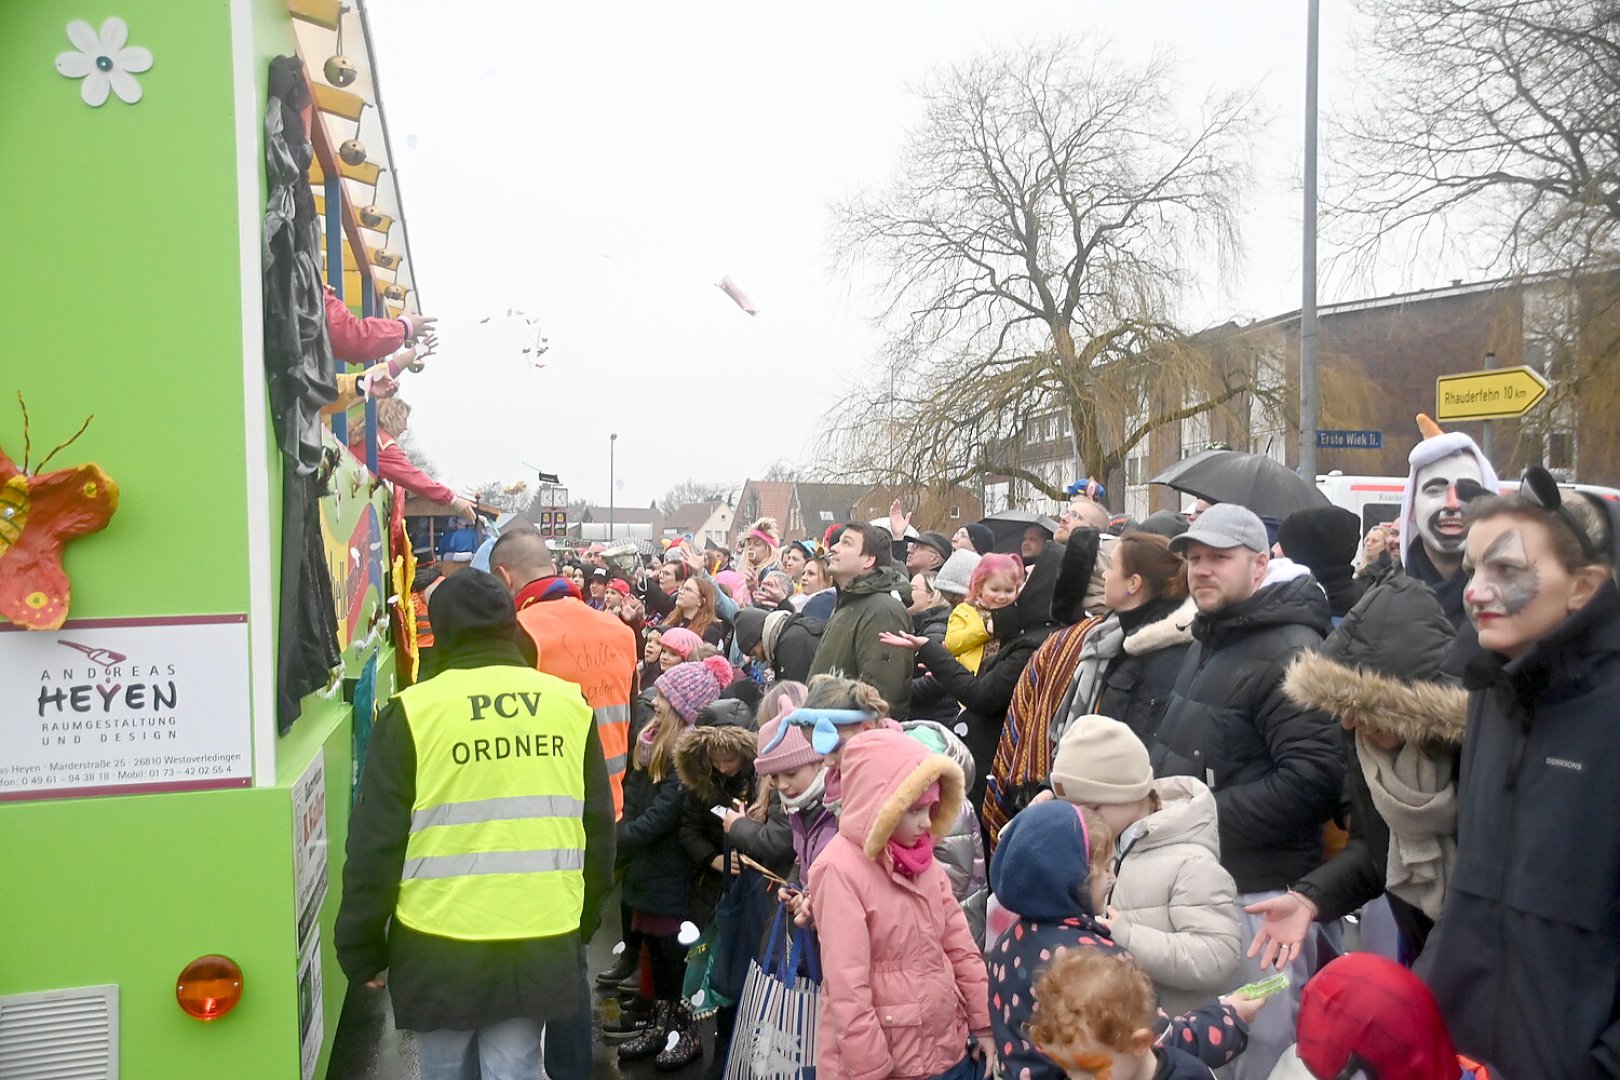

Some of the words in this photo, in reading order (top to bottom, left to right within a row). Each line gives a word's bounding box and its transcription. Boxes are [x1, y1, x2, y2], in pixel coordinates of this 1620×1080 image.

[1444, 389, 1500, 405] Rhauderfehn
[1504, 385, 1513, 400] 10
[1515, 389, 1527, 399] km
[1320, 432, 1344, 444] Erste
[1346, 432, 1367, 445] Wiek
[40, 664, 176, 681] ANDREAS
[38, 680, 177, 717] HEYEN
[467, 691, 542, 721] PCV
[42, 716, 176, 732] RAUMGESTALTUNG
[42, 735, 81, 746] UND
[100, 730, 176, 743] DESIGN
[452, 734, 564, 765] ORDNER
[11, 765, 41, 775] Heyen
[49, 759, 111, 772] Marderstraße
[114, 759, 126, 768] 25
[134, 757, 161, 767] 26810
[164, 753, 241, 765] Westoverledingen
[31, 776, 43, 785] 49
[46, 775, 56, 784] 61
[68, 774, 80, 783] 94
[83, 773, 95, 782] 38
[99, 772, 110, 781] 18
[118, 770, 147, 780] Mobil:
[149, 769, 159, 778] 01
[164, 768, 174, 777] 73
[184, 767, 195, 776] 42
[198, 766, 208, 775] 02
[212, 765, 223, 774] 55
